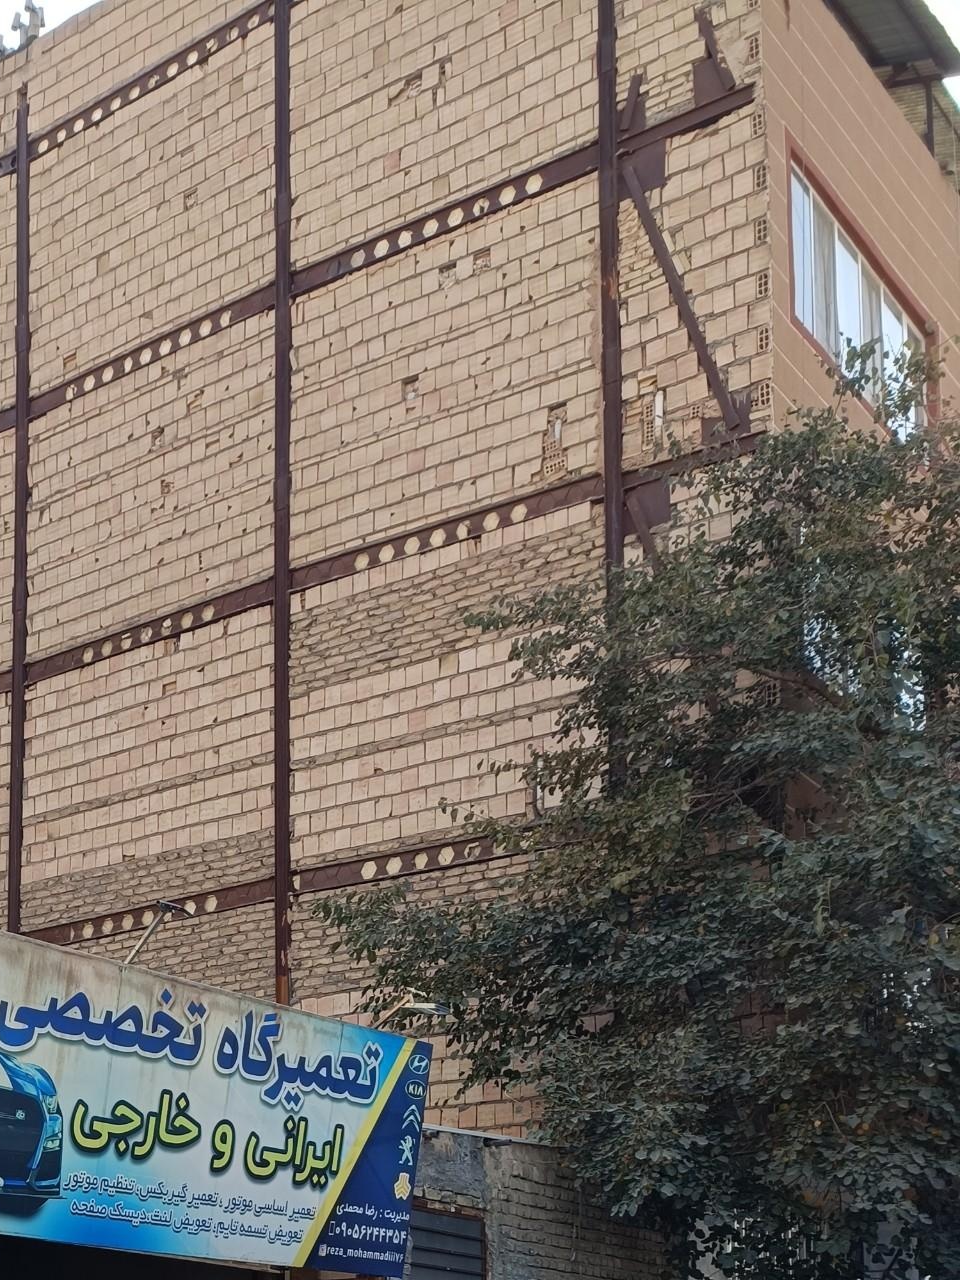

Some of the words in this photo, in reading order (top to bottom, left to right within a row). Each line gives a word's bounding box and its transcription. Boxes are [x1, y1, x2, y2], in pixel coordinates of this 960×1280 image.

[214, 1010, 384, 1113] تعمیرگاه
[71, 1089, 201, 1159] خارجی
[210, 1119, 236, 1172] و
[244, 1114, 344, 1188] ایرانی
[62, 1170, 99, 1191] موتور
[100, 1174, 136, 1195] تنظیم
[70, 1198, 108, 1219] صفحه
[253, 1200, 288, 1216] اساسی
[288, 1205, 317, 1221] تعمیر
[336, 1203, 363, 1215] محمدی
[365, 1203, 378, 1220] رضا
[384, 1208, 410, 1223] مدیریت
[172, 1211, 213, 1235] تعویض
[239, 1223, 268, 1238] تسمه
[268, 1224, 305, 1246] تعویض
